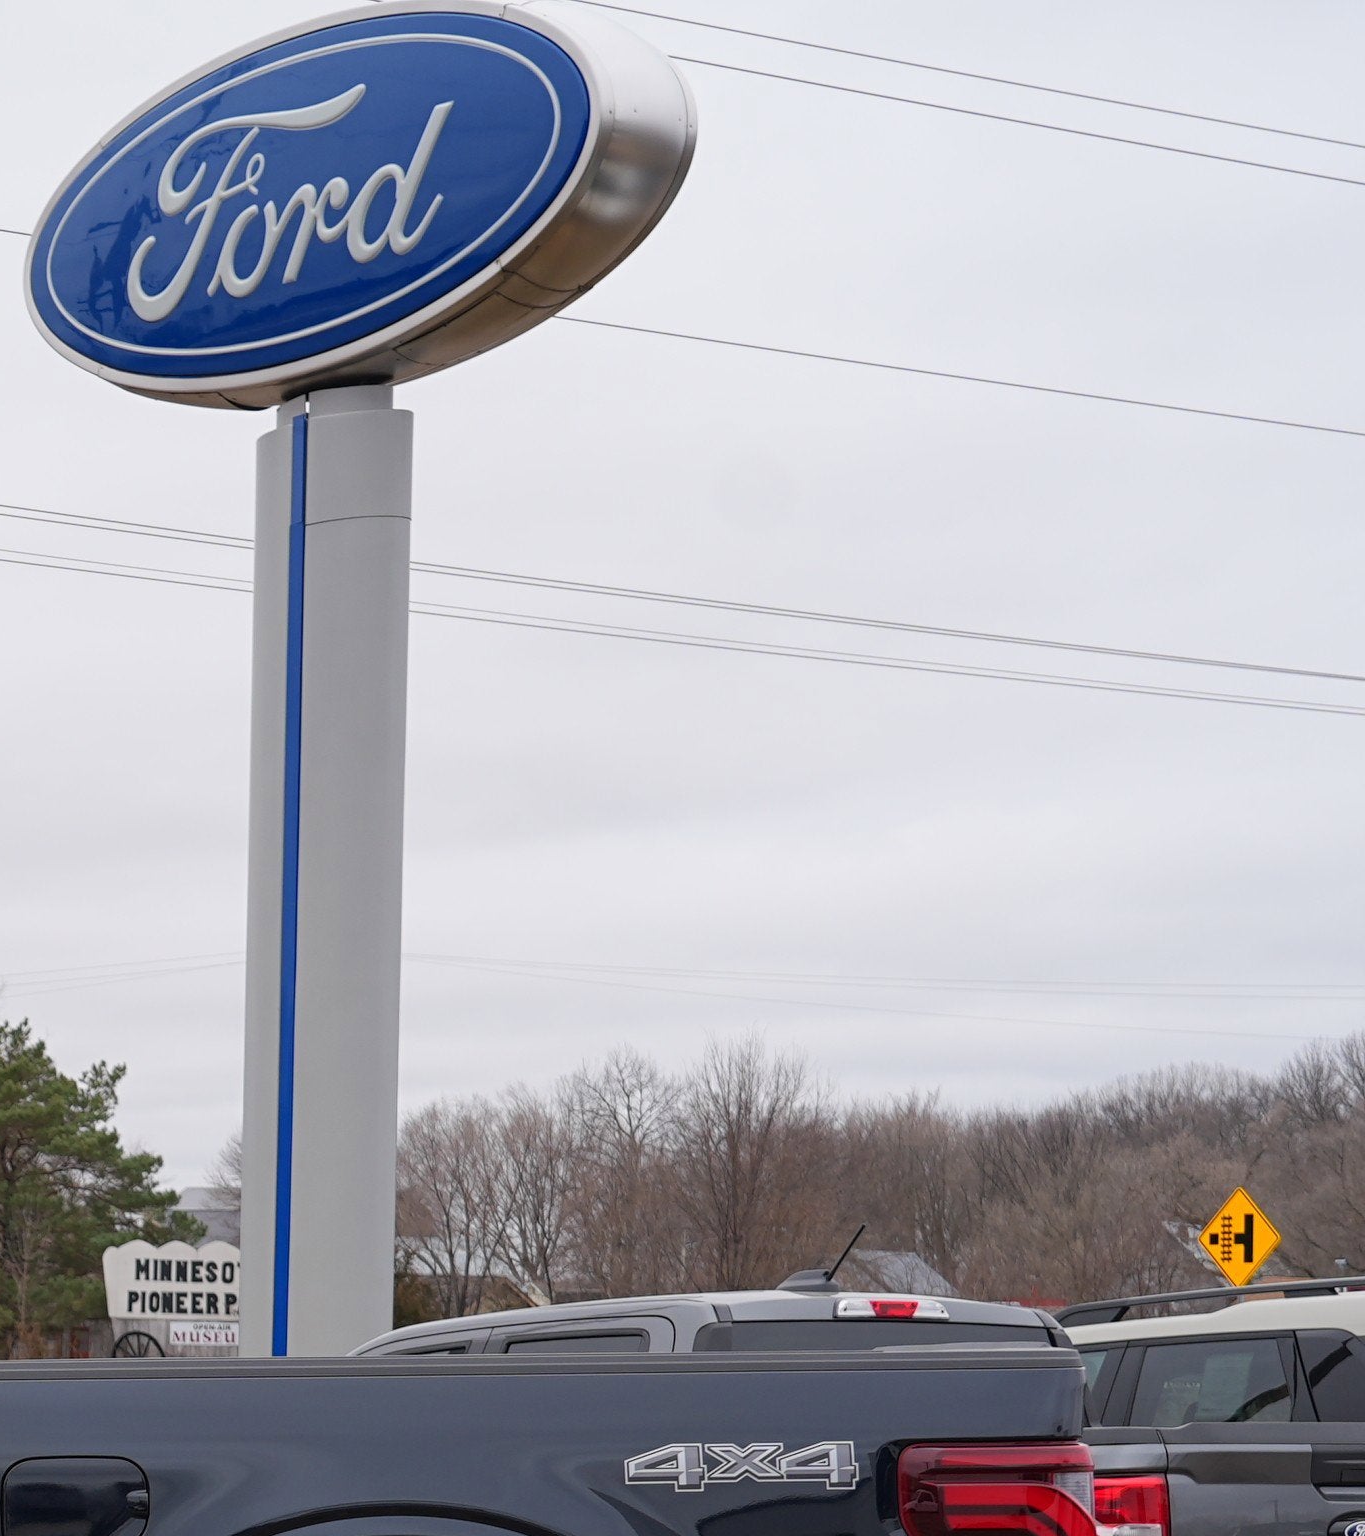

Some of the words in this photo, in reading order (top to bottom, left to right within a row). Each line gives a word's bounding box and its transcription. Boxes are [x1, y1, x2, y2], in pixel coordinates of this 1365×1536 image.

[127, 83, 454, 322] Ford
[135, 1259, 240, 1283] MINNESO
[127, 1291, 219, 1315] PIONEER
[224, 1293, 239, 1315] P
